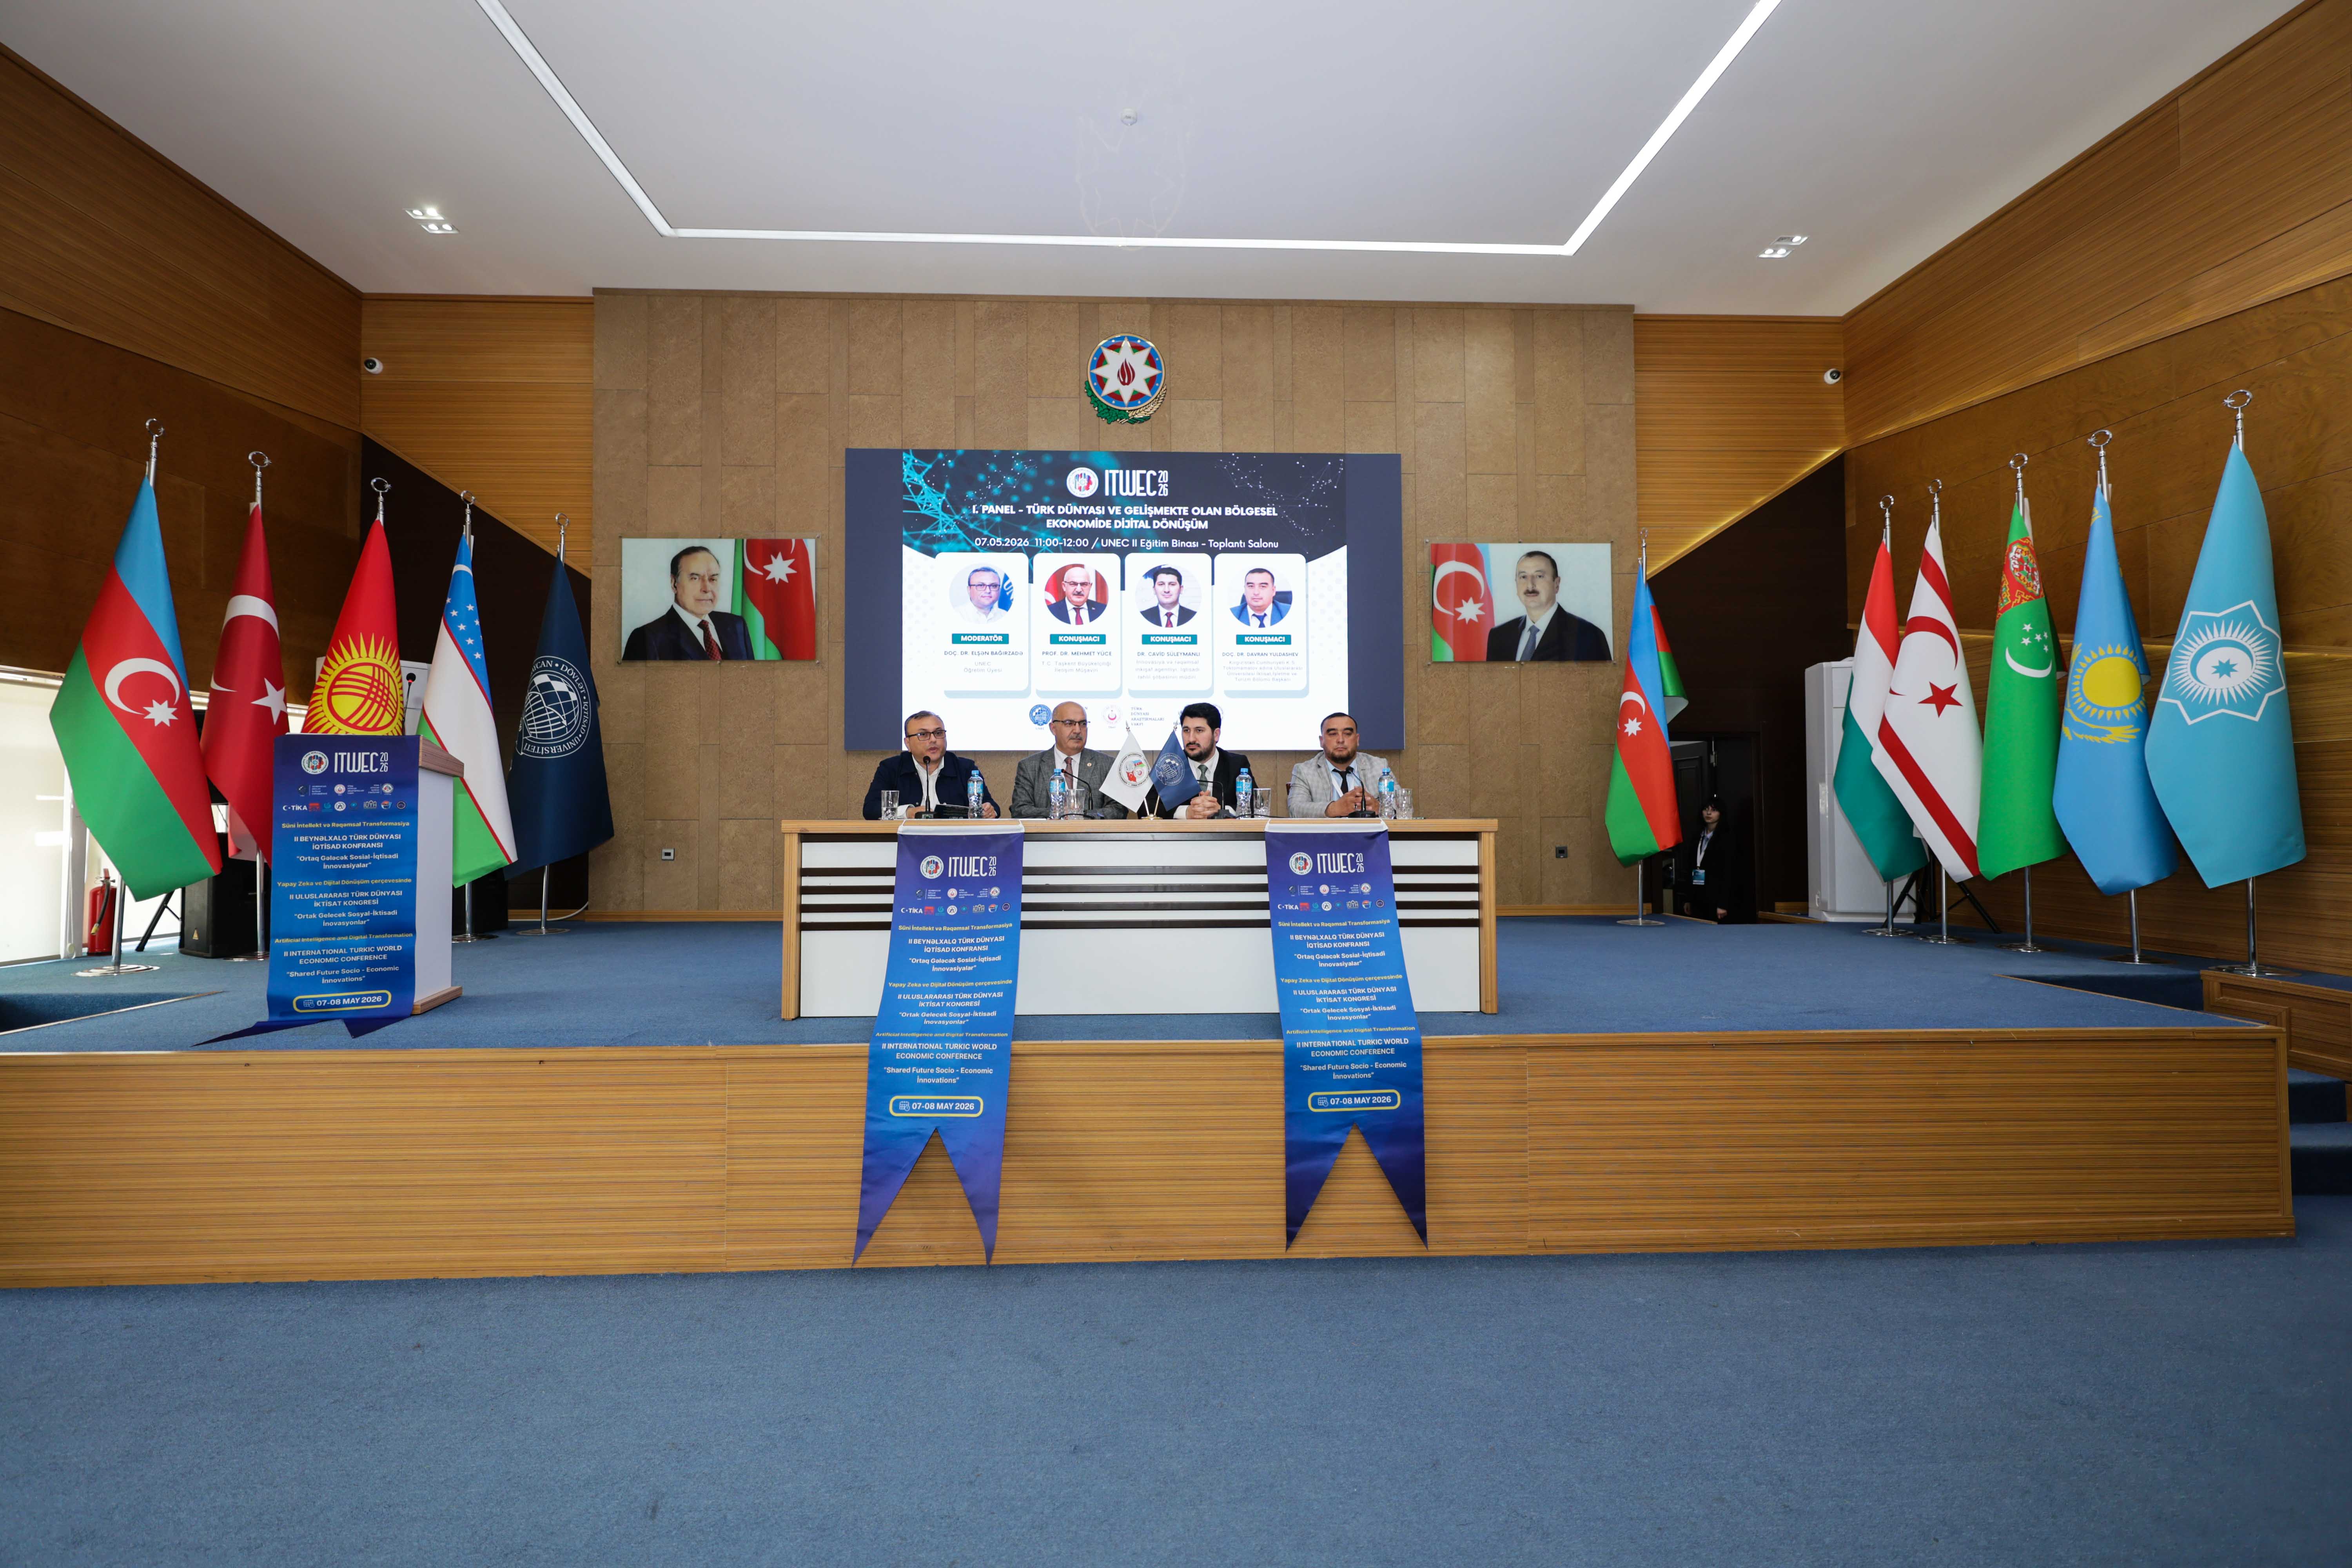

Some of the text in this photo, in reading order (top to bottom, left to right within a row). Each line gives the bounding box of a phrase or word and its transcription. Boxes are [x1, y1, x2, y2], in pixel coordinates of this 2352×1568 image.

[1105, 470, 1157, 496] ITWEC
[1158, 470, 1168, 483] 20
[1158, 484, 1168, 496] 26
[982, 505, 1015, 514] PANEL
[1026, 503, 1055, 514] TÜRK
[1058, 504, 1105, 514] DÜNYASI
[1124, 504, 1189, 517] GELİŞMEKTE
[1192, 507, 1221, 515] OLAN
[1225, 504, 1278, 515] BÖLGESEL
[1047, 517, 1208, 531] EKONOMİDE DİJİTAL DÖNÜŞÜM
[975, 538, 1029, 546] 07.05.2026
[1035, 538, 1089, 546] 11:00-12:00
[1091, 537, 1098, 549] /
[1140, 539, 1169, 550] Eğitim
[1209, 538, 1245, 550] Toplantı
[1248, 538, 1278, 548] Salonu
[560, 664, 586, 693] DÖVLƏT
[334, 752, 378, 773] ITWEC
[380, 752, 388, 761] 20
[380, 762, 388, 772] 26
[989, 857, 996, 866] 20
[1317, 853, 1356, 873] ITWEC
[1356, 853, 1363, 862] 20
[949, 857, 988, 877] ITWEC
[989, 867, 996, 876] 26
[1357, 863, 1364, 872] 26
